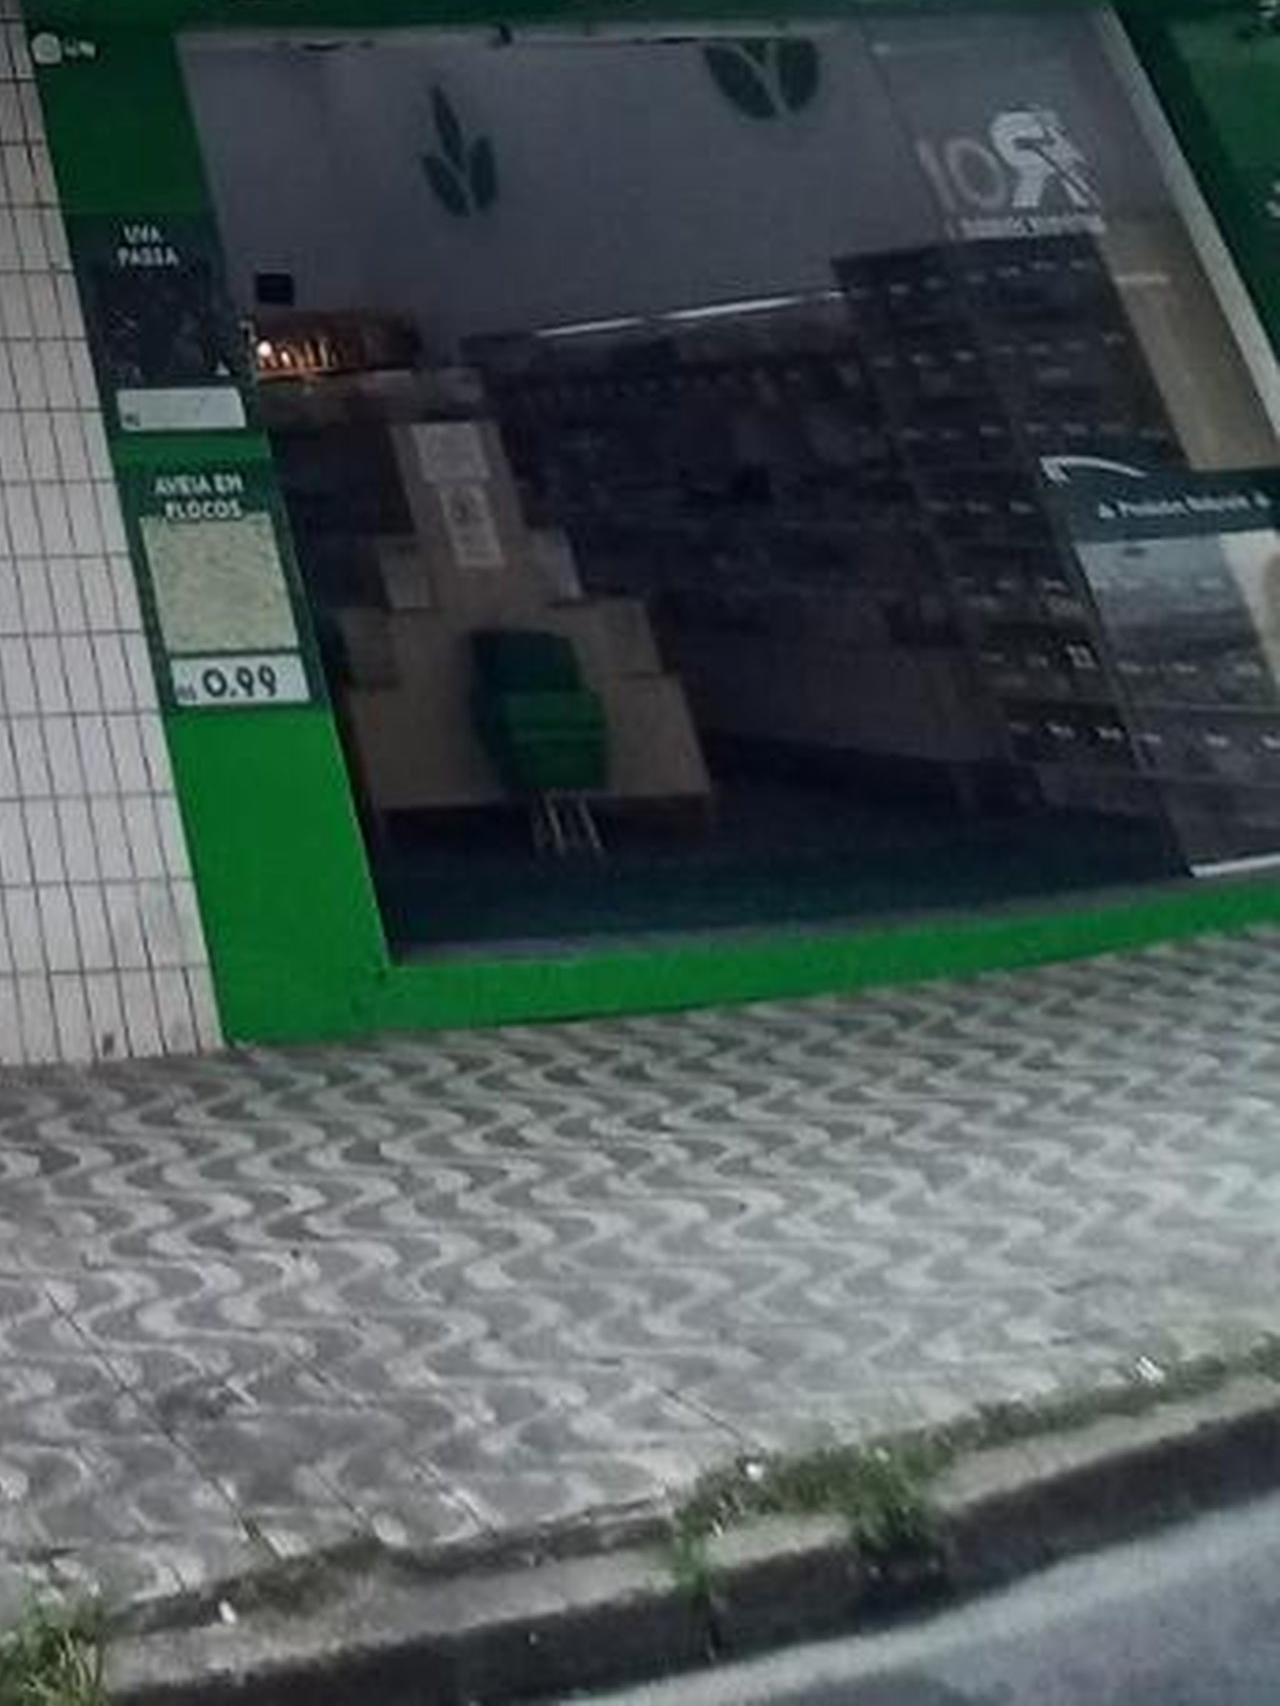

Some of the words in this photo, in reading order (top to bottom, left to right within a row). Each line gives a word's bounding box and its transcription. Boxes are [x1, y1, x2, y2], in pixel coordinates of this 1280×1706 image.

[122, 224, 163, 245] UVA
[117, 246, 180, 269] PASSA
[154, 474, 211, 496] AVEIA
[213, 473, 245, 494] EM
[165, 500, 243, 520] FLOCOS
